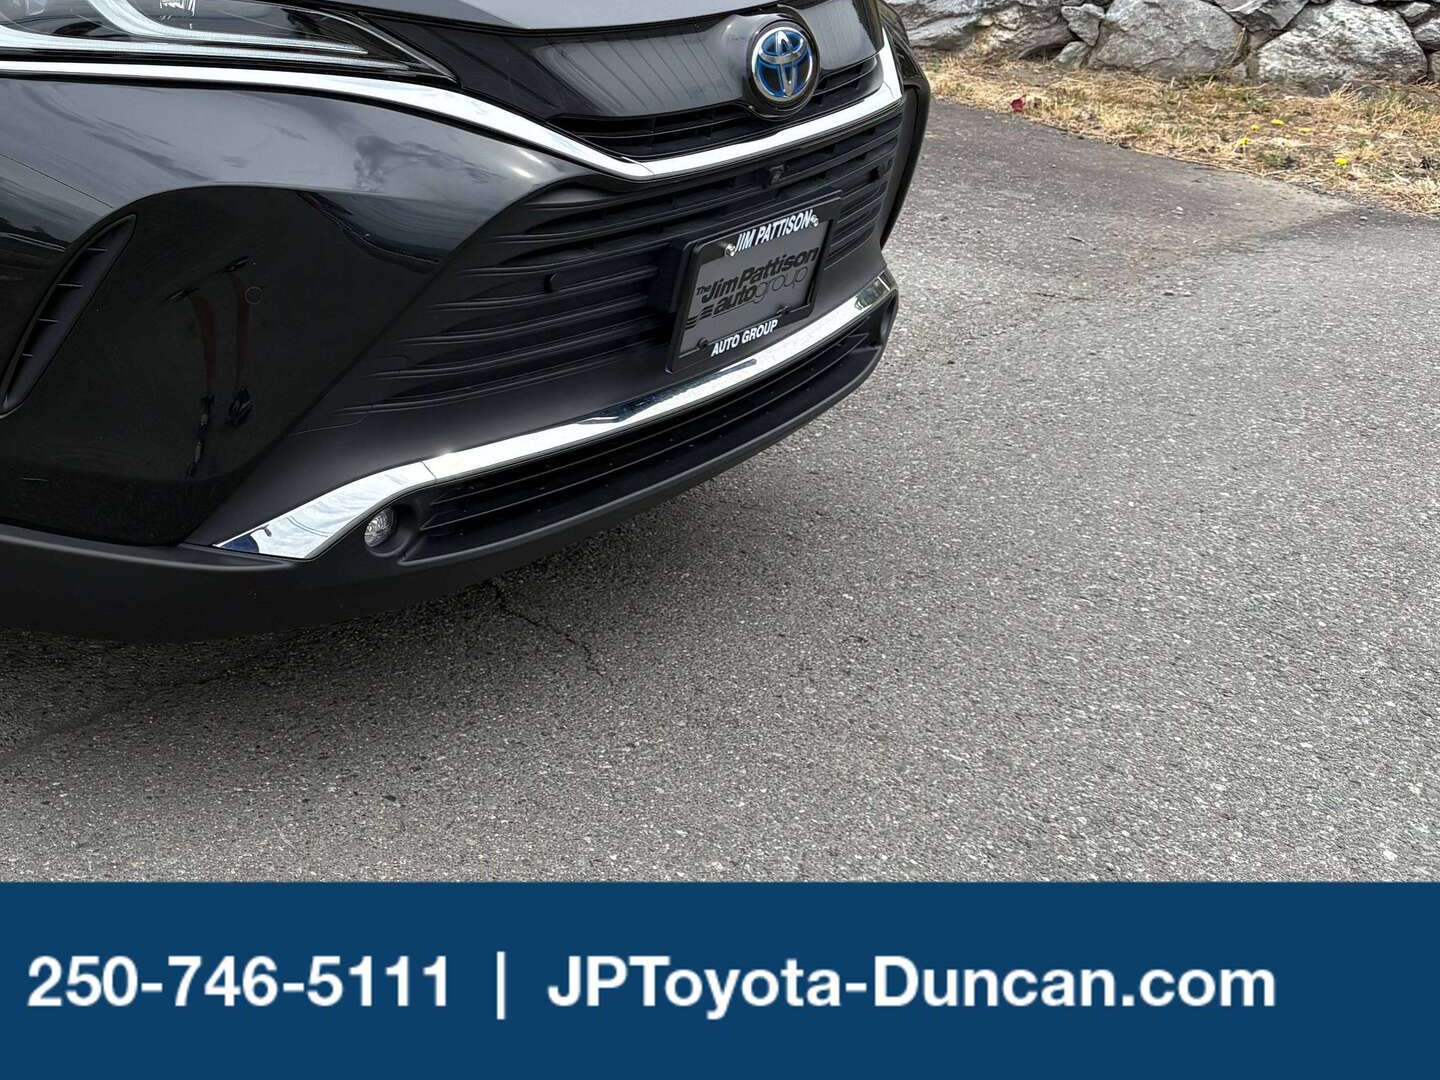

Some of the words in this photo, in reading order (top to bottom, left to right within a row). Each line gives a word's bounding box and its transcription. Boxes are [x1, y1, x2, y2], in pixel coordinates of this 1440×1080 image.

[734, 229, 756, 252] JIM
[755, 209, 813, 245] PATTISON
[711, 334, 740, 357] AUTO
[741, 319, 778, 345] GROUP
